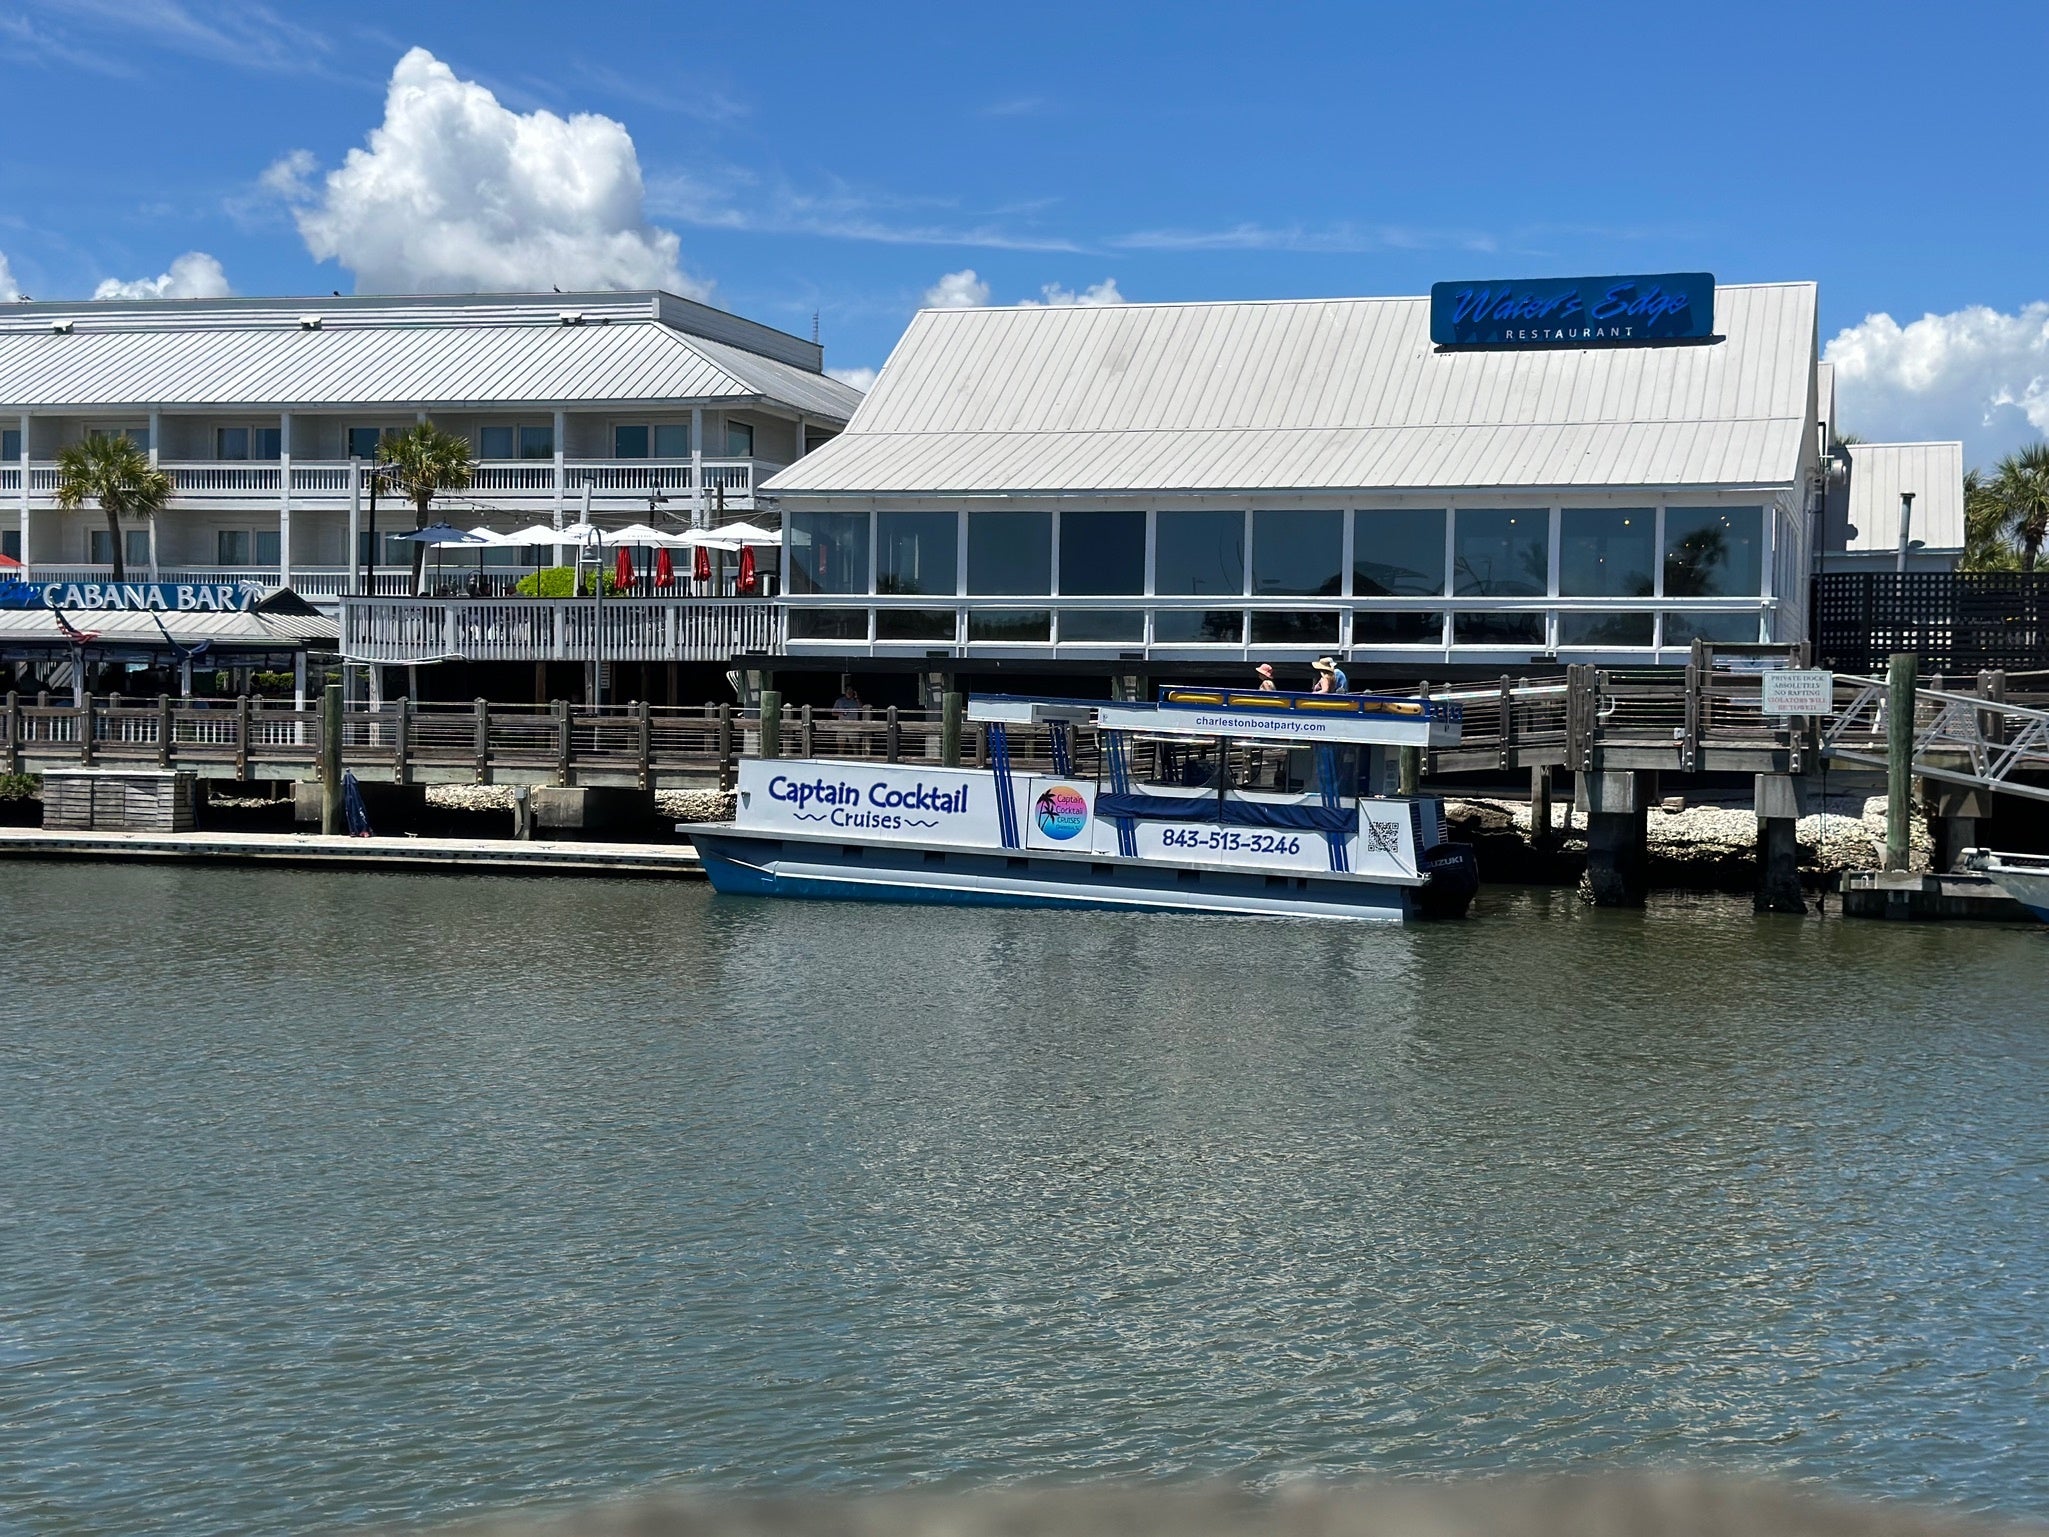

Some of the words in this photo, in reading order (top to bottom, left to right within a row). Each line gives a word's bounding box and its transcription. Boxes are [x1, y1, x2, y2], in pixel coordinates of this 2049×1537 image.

[1453, 287, 1583, 323] Water's
[1592, 280, 1689, 327] Edge
[1505, 326, 1633, 339] RESTAURANT
[43, 583, 168, 610] CABANA
[177, 584, 237, 611] BAR
[1196, 716, 1326, 732] charlestonboatparty.com
[769, 776, 860, 809] Captain
[868, 782, 968, 814] Cocktail
[1057, 794, 1083, 804] Captain
[830, 808, 901, 829] Cruises
[1162, 828, 1300, 855] 843-513-3246
[1430, 855, 1464, 868] UZUKI
